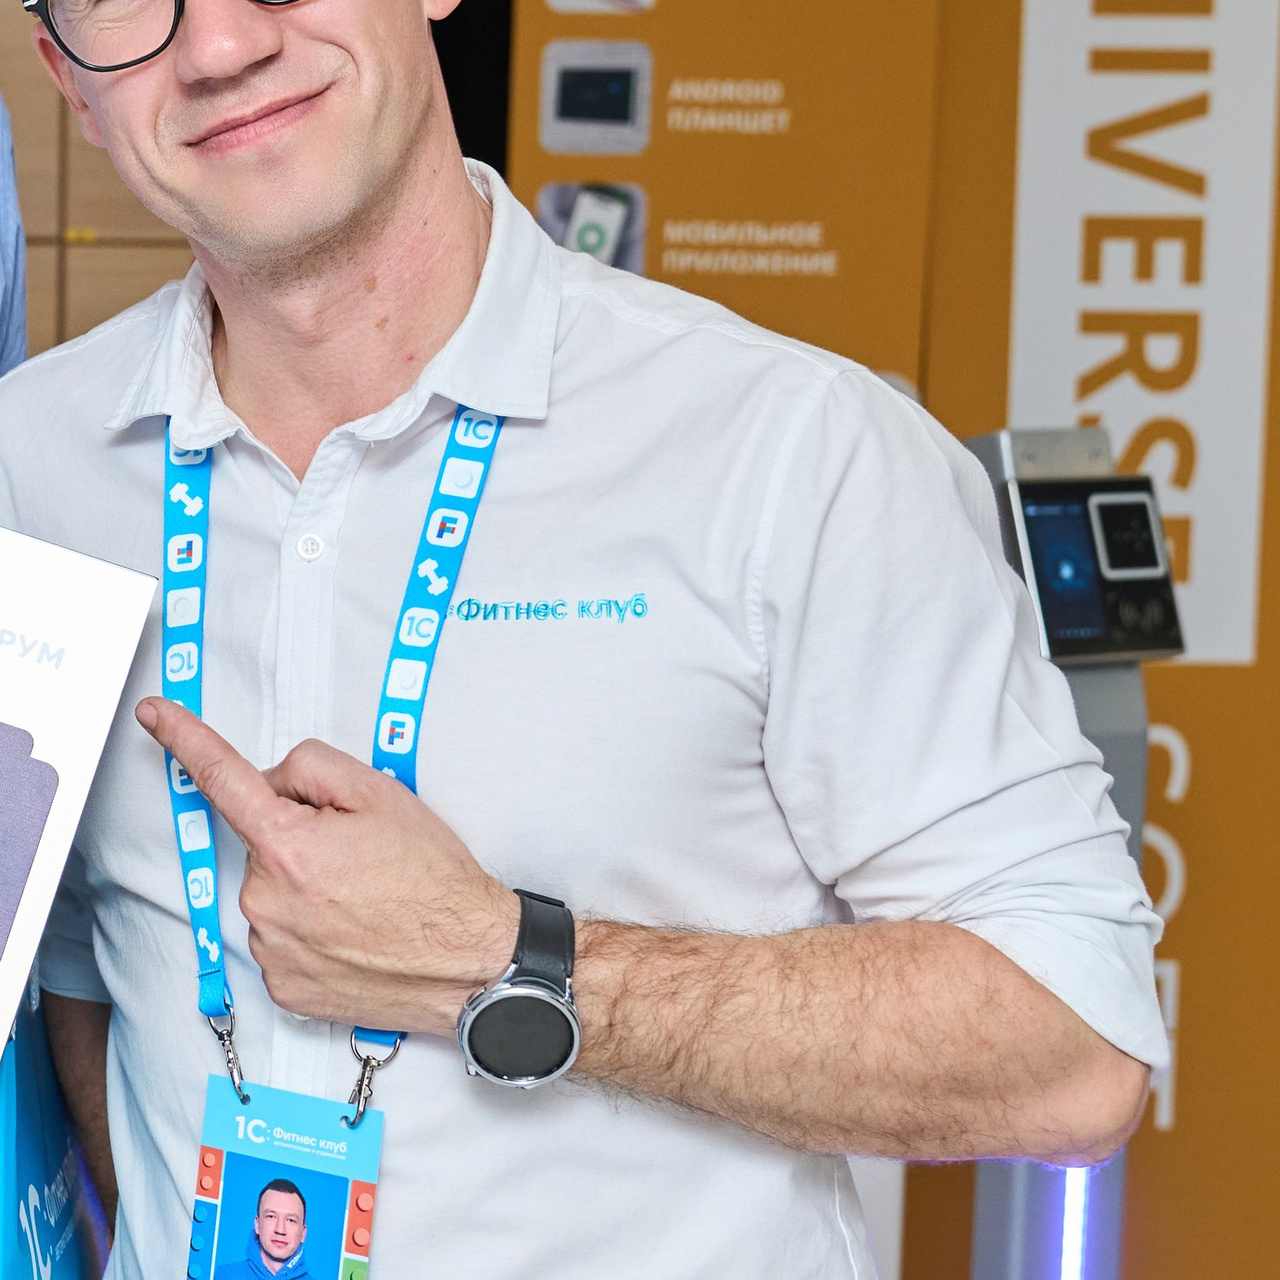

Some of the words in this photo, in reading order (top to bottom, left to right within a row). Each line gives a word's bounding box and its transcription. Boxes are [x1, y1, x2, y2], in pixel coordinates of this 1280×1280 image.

[663, 220, 824, 247] МОБИЛЬНОЕ
[662, 248, 838, 276] ПРИЛОЖЕНИЕ
[456, 597, 568, 621] Фитнес
[578, 593, 648, 624] клуб
[319, 1139, 347, 1154] клуб
